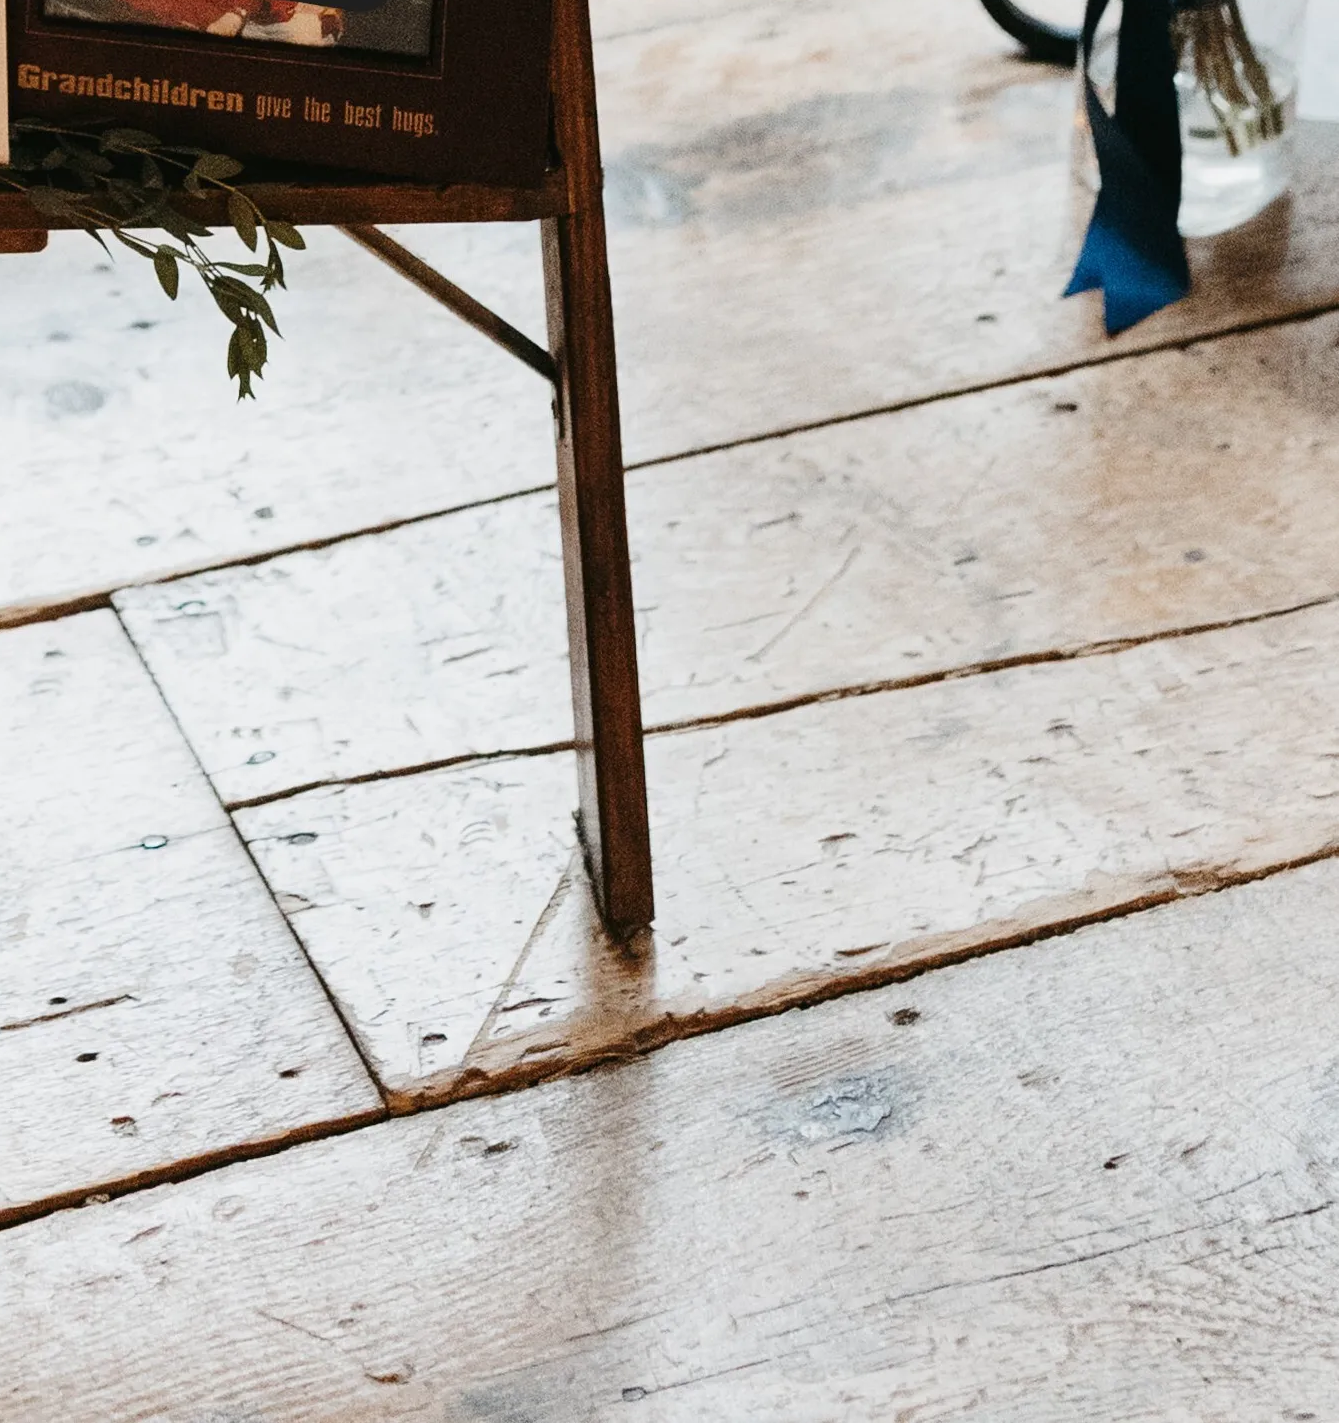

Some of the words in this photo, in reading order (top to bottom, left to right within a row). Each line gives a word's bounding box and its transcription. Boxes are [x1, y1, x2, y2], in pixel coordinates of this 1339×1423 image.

[17, 63, 244, 113] Grandchildren
[255, 93, 292, 120] give
[304, 95, 331, 123] the
[344, 99, 382, 129] best
